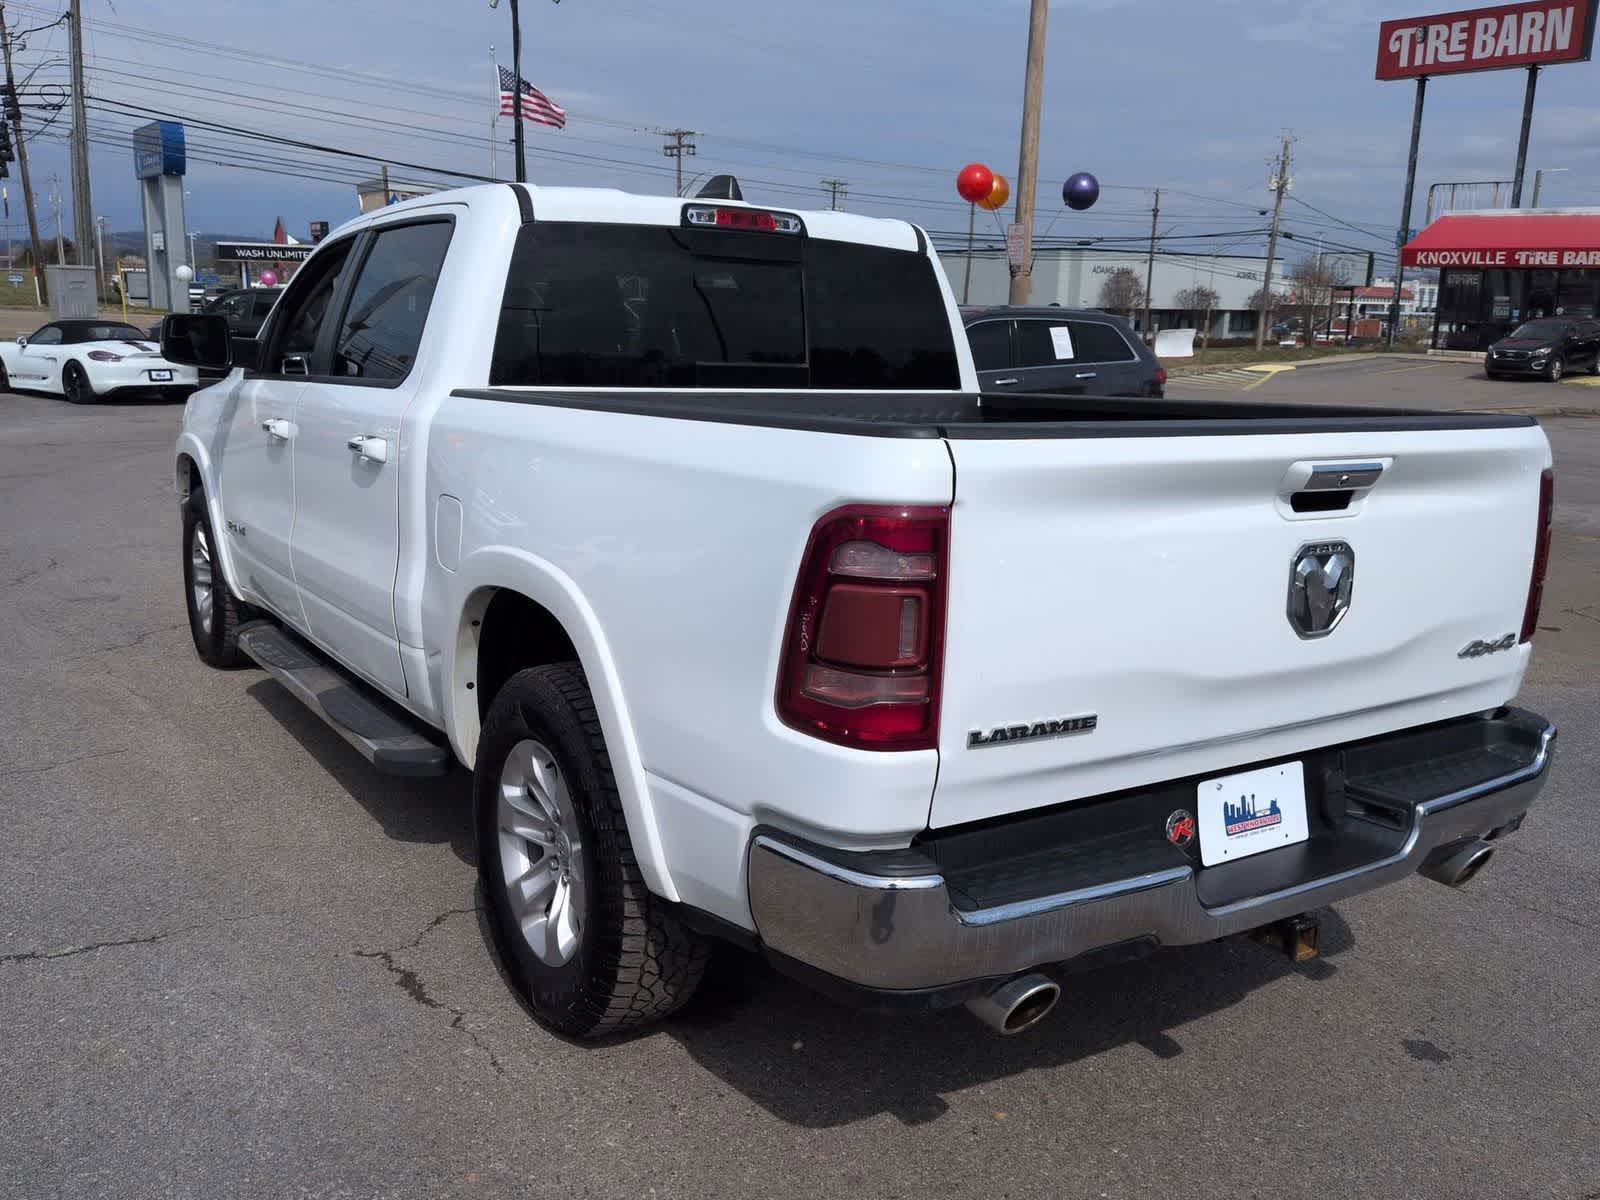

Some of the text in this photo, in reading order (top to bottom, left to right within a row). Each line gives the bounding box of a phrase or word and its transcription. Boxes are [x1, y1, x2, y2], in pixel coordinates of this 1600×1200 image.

[1471, 6, 1575, 60] BARN
[236, 249, 265, 257] WASH
[1416, 251, 1506, 265] KNOXVILLE
[967, 714, 1097, 750] LARAMIE
